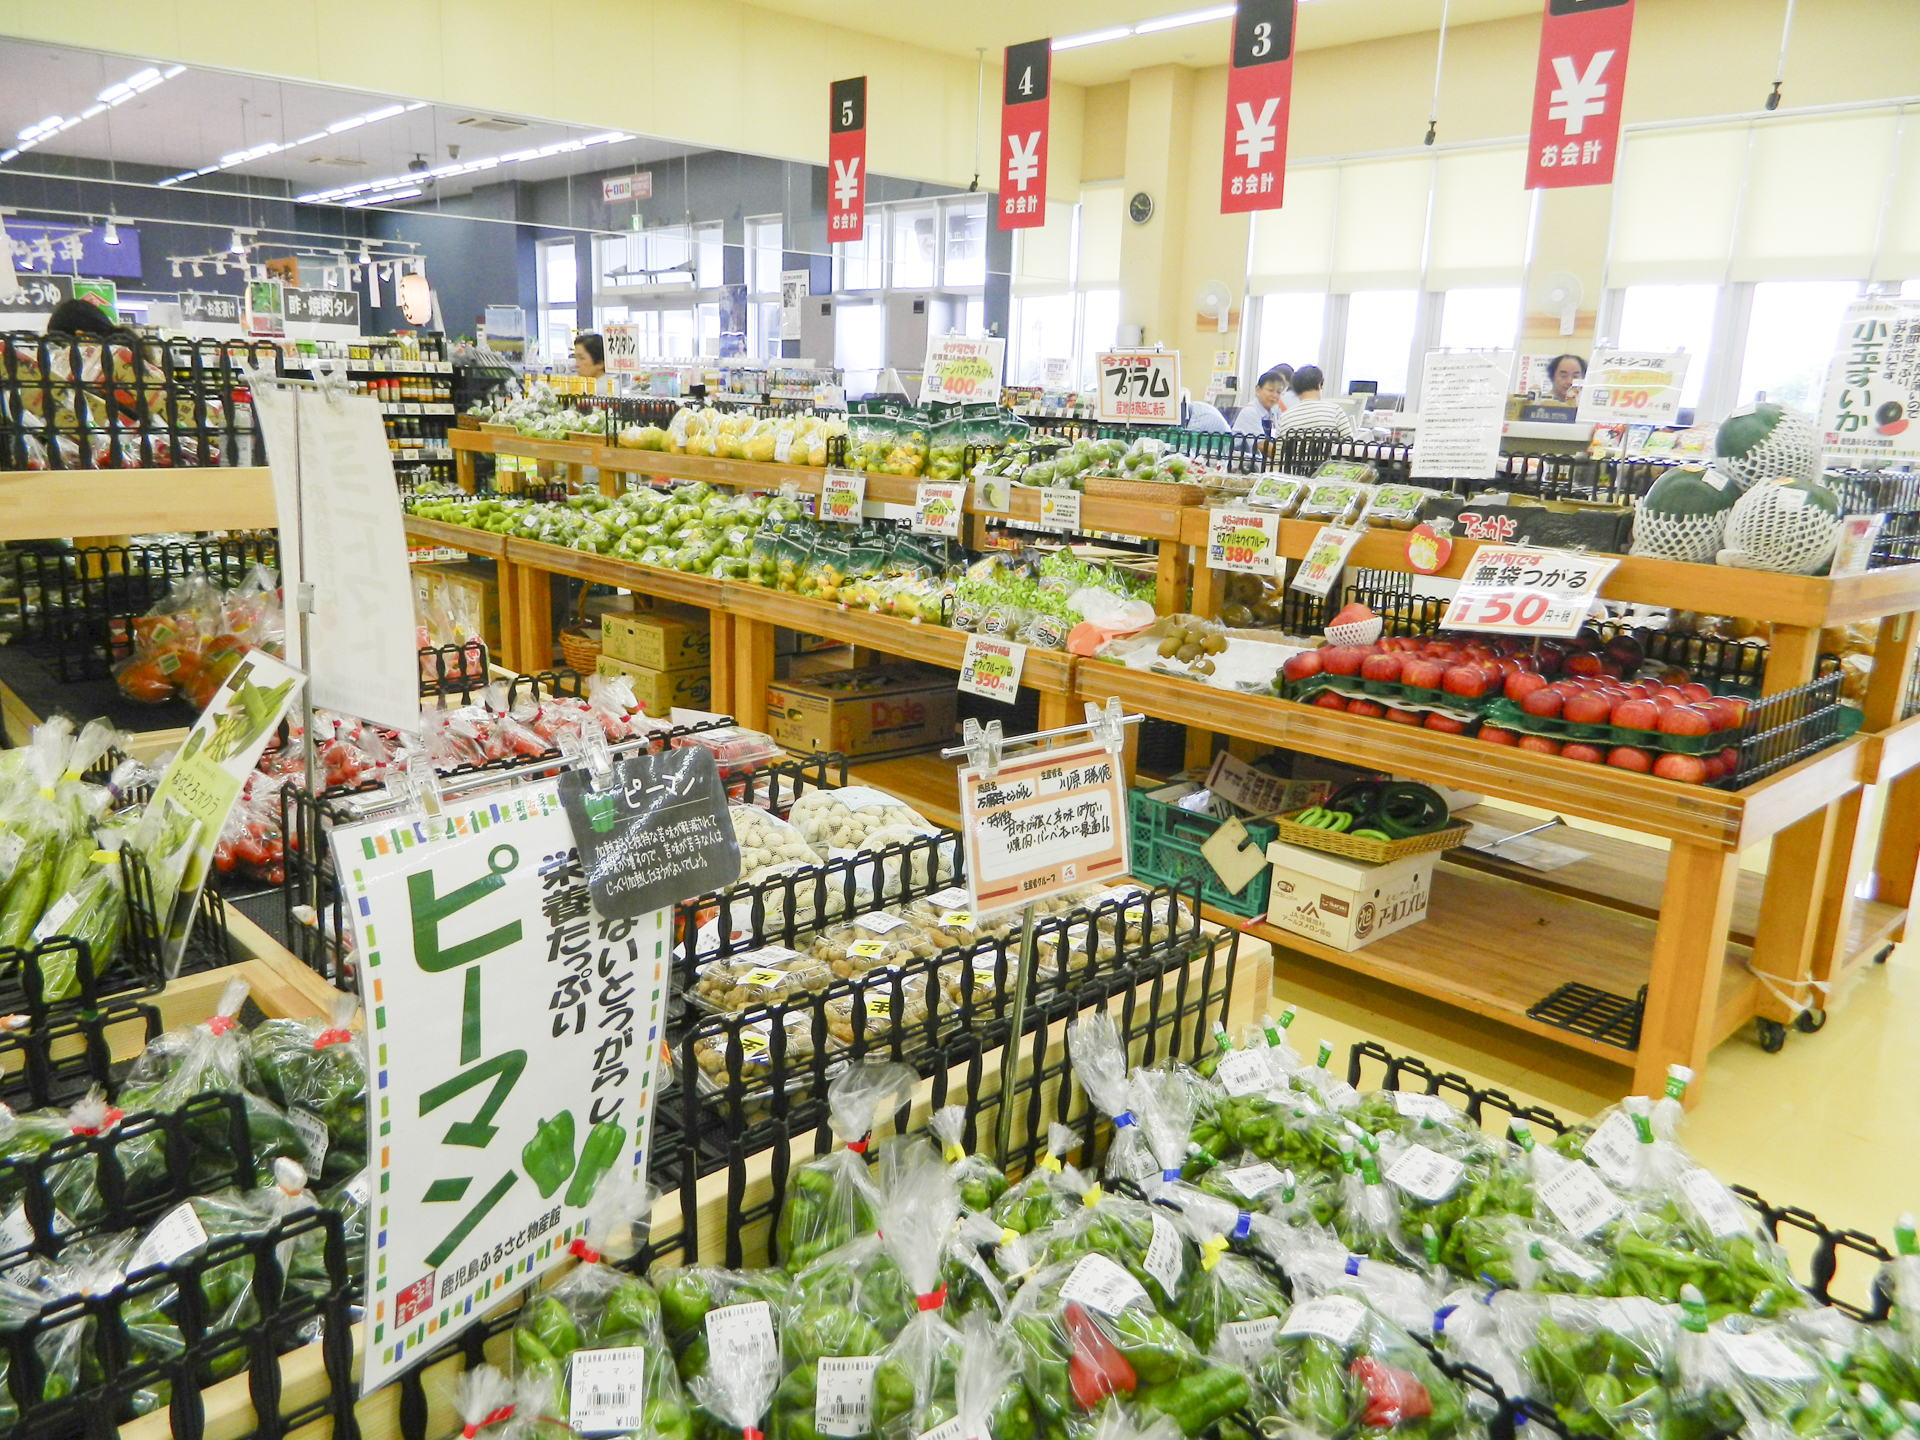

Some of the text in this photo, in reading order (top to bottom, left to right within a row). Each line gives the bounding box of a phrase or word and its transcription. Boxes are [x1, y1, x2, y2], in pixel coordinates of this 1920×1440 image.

[1251, 22, 1273, 58] 3
[1018, 66, 1034, 96] 4
[841, 100, 855, 127] 5
[1540, 140, 1602, 168] お会計
[1230, 172, 1274, 195] お会計
[1005, 194, 1039, 215] お会計
[832, 212, 859, 230] お会計
[287, 294, 355, 318] 酢・焼肉タレ
[1101, 355, 1151, 368] 今が旬
[1602, 357, 1667, 369] メキシコ産
[1105, 366, 1171, 398] プラム
[1834, 319, 1888, 433] 小玉すいか
[1477, 552, 1545, 567] 今が旬です
[1472, 565, 1588, 589] 無袋つがる
[871, 698, 926, 730] Dole
[624, 776, 697, 809] ピーマン
[977, 781, 998, 794] 商品名
[1023, 874, 1057, 892] 生産者グループ
[537, 847, 593, 1039] 栄養たっぷり
[407, 843, 528, 1269] ピーマン
[441, 1204, 562, 1300] 鹿児島ふるさと物産館
[582, 1366, 635, 1378] ピーマン
[615, 1415, 640, 1428] ¥100
